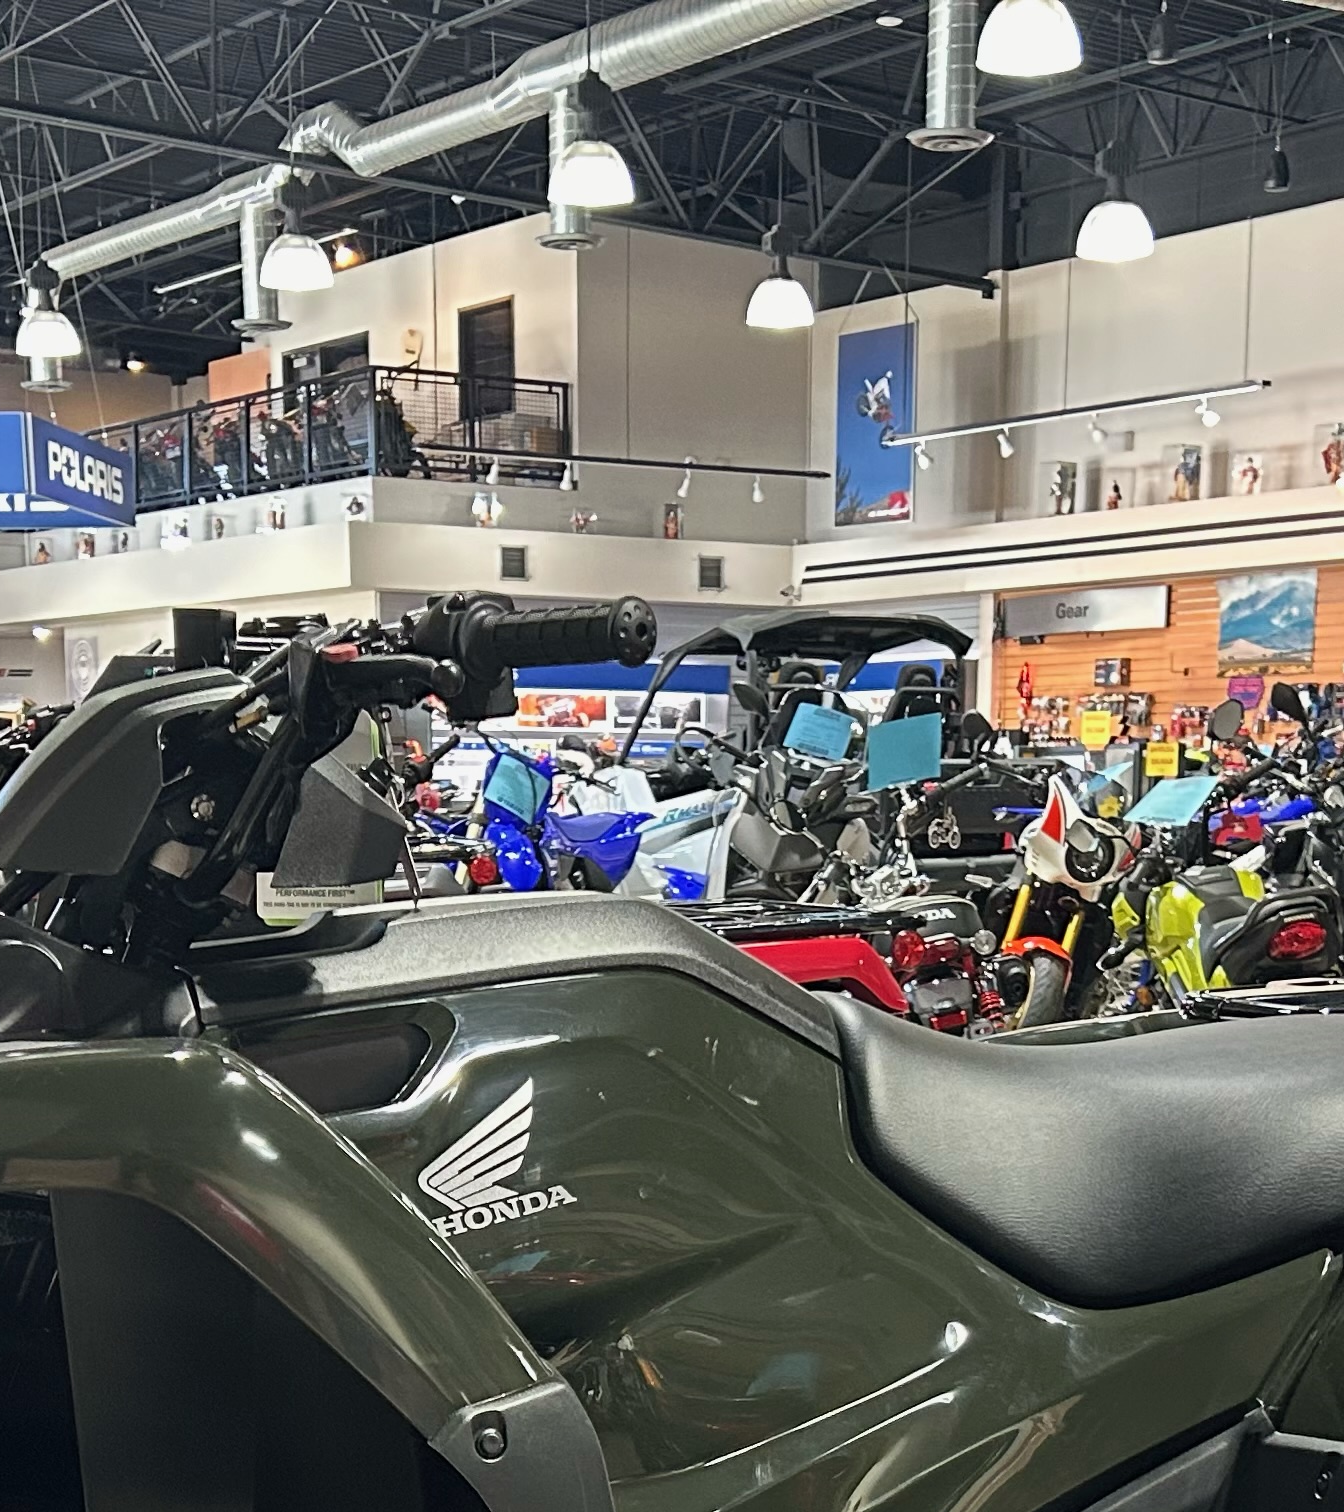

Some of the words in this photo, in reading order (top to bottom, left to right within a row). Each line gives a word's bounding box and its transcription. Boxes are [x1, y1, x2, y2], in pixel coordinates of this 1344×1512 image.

[47, 440, 123, 506] POLARIS
[1056, 602, 1090, 620] Gear
[275, 888, 327, 898] PERFORMANCE
[431, 1184, 578, 1239] HONDA
